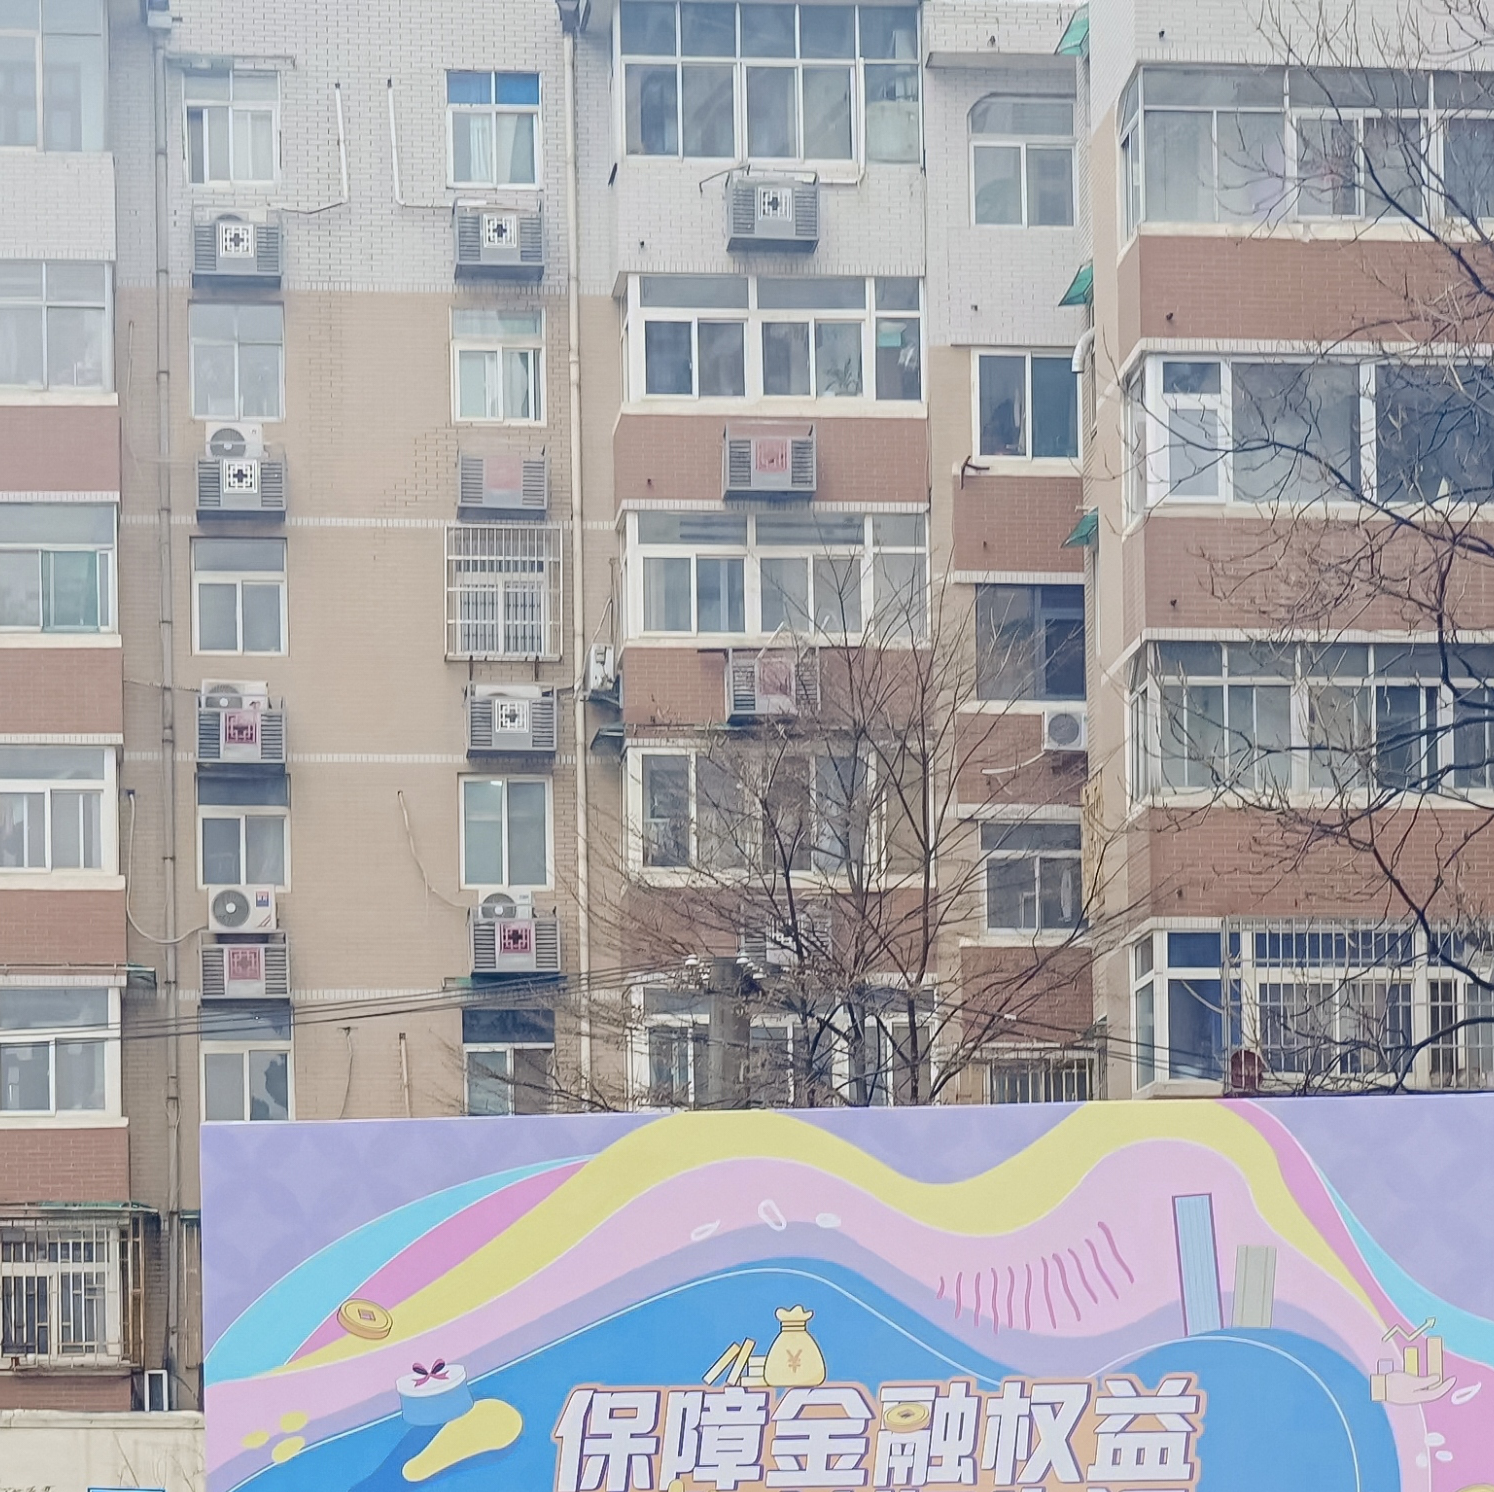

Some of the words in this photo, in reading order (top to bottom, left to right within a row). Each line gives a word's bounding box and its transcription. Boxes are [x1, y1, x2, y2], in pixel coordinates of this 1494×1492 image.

[554, 1377, 1199, 1492] 保障金融权益
